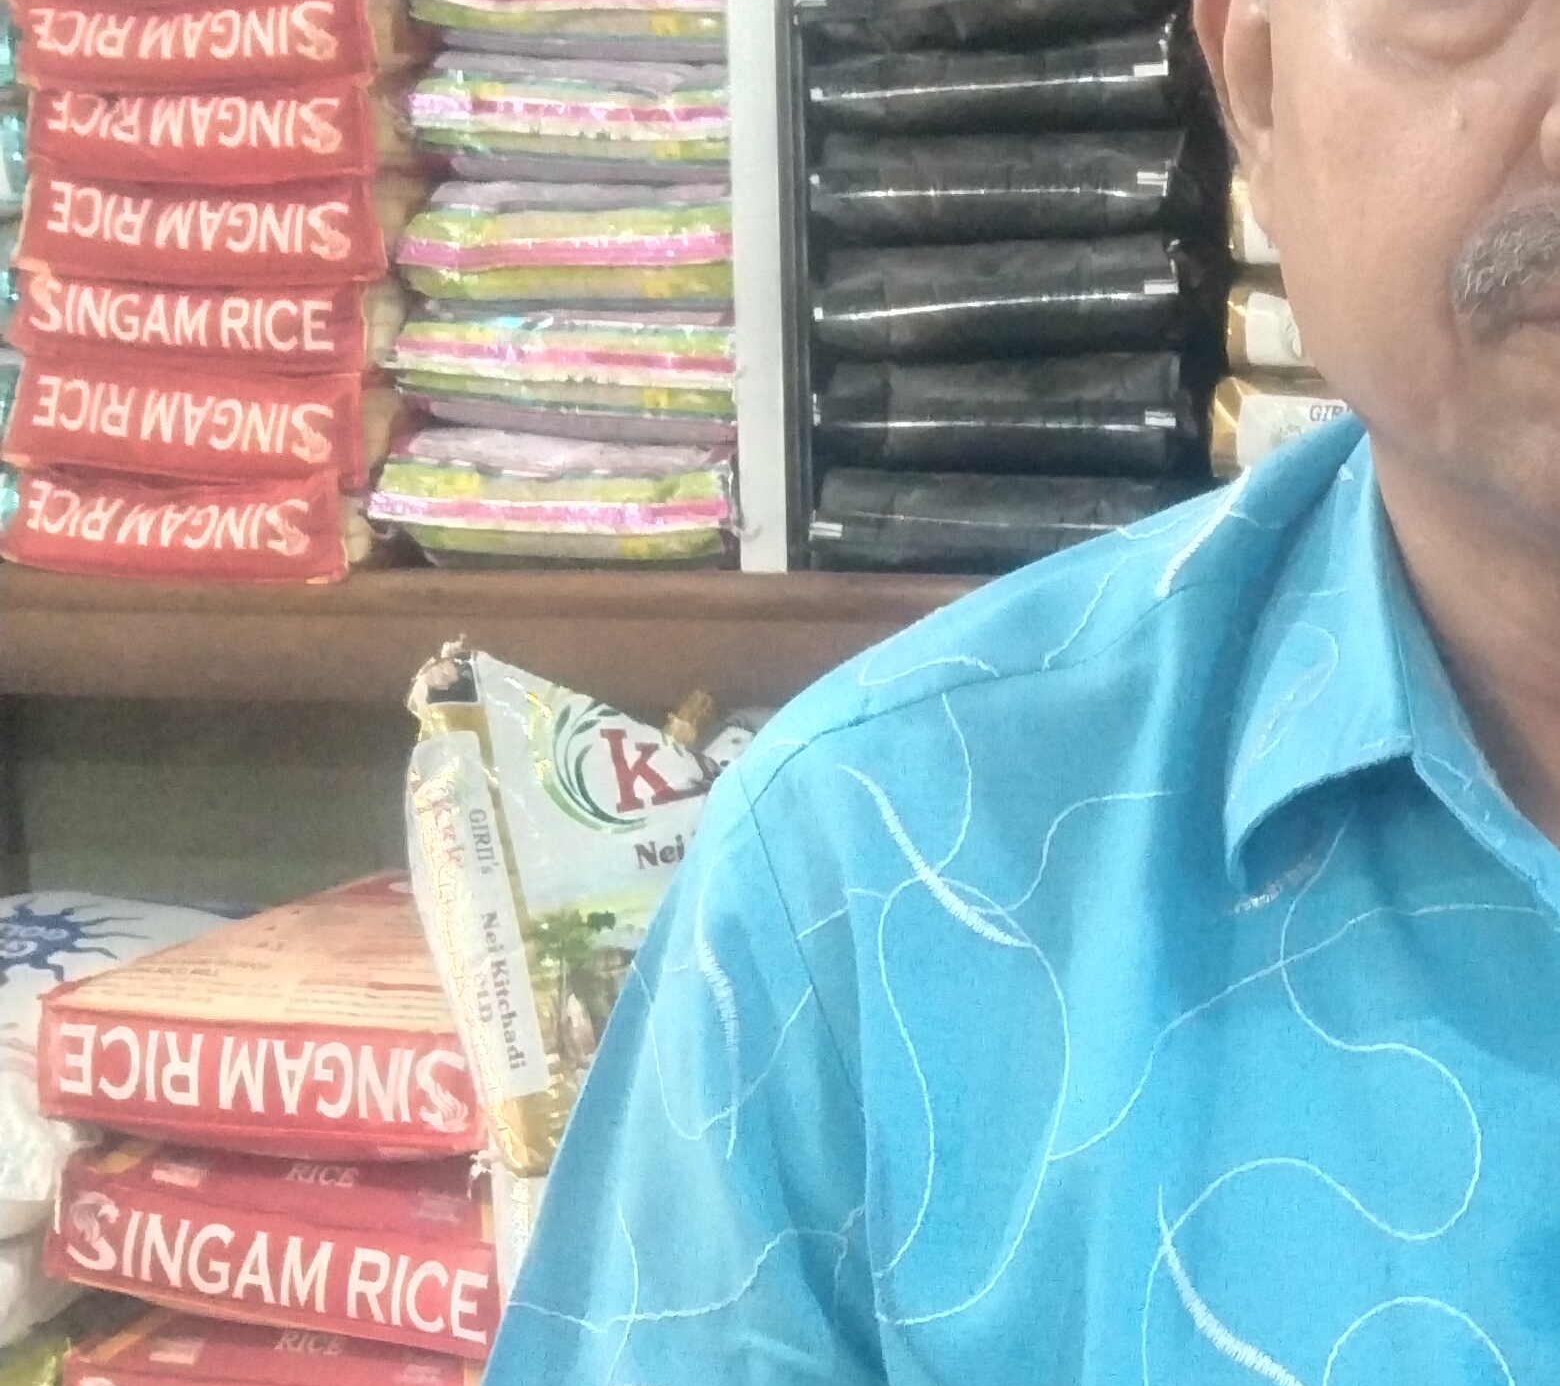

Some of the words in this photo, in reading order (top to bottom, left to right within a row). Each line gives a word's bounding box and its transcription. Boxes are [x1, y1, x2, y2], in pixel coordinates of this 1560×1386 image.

[29, 8, 135, 58] RICE
[138, 1, 338, 61] SINGAM
[48, 91, 142, 142] RICE
[149, 96, 343, 154] SINGAM
[46, 180, 152, 247] RICE
[155, 199, 351, 261] SINGAM
[28, 274, 211, 347] SINGAM
[220, 296, 335, 353] RICE
[32, 375, 136, 438] RICE
[140, 387, 334, 464] SINGAM
[26, 480, 124, 541] RICE
[117, 497, 310, 557] SINGAM
[482, 910, 503, 956] Nei
[488, 958, 529, 1073] Kitchadi
[58, 1023, 204, 1104] RICE
[217, 1034, 470, 1134] SINGAM
[65, 1190, 334, 1314] SINGAM
[346, 1247, 491, 1343] RICE
